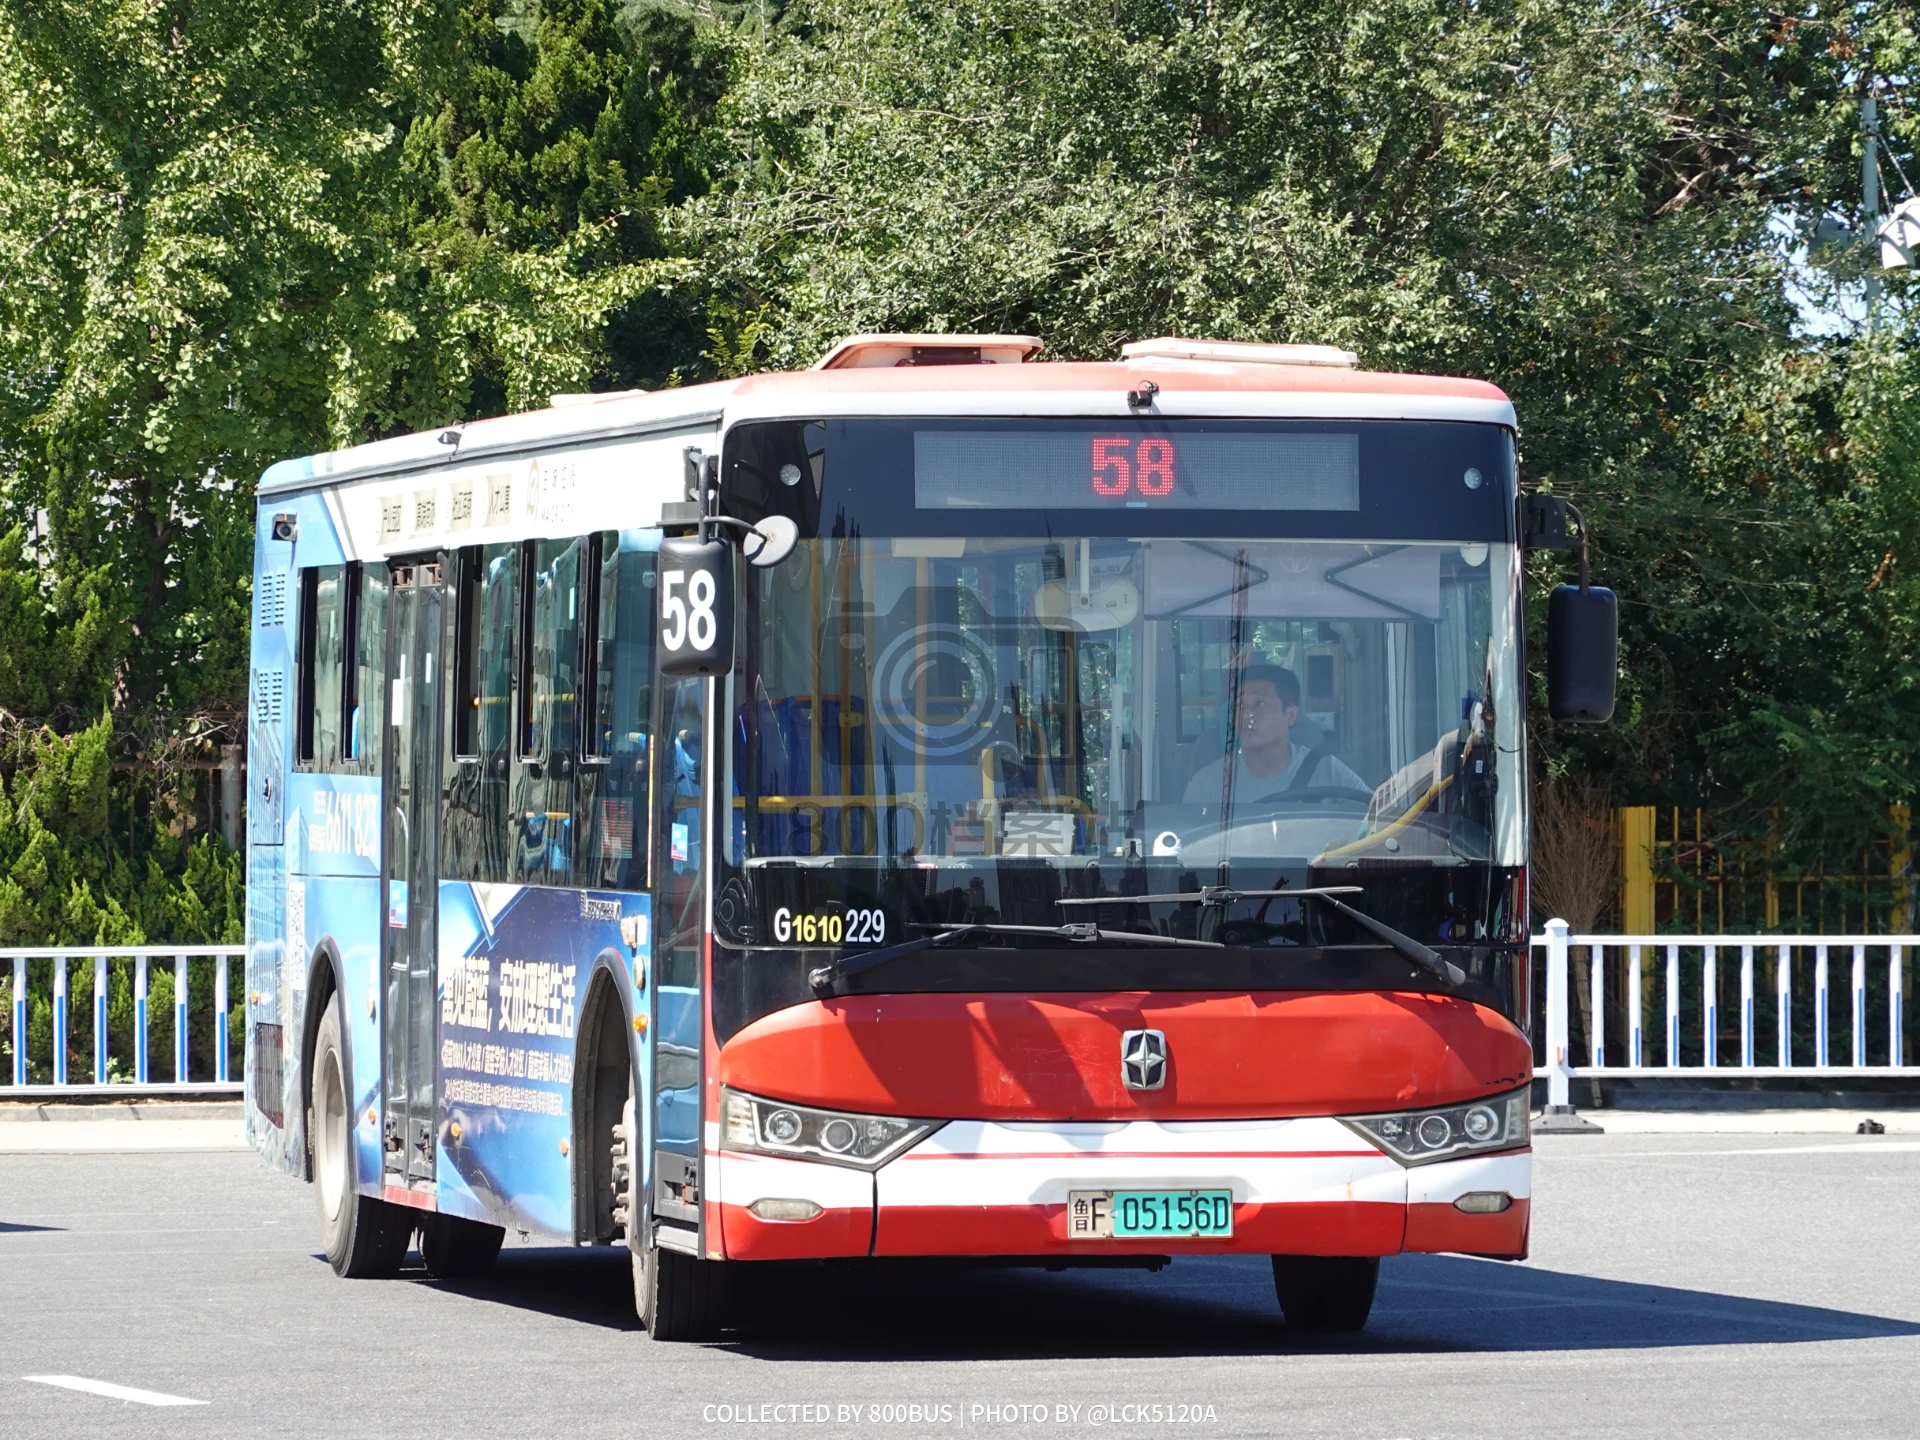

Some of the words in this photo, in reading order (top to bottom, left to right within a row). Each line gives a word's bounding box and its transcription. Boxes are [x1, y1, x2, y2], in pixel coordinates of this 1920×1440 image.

[1093, 438, 1174, 496] 58
[662, 569, 717, 652] 58
[326, 790, 352, 854] 6611
[354, 791, 378, 857] 823
[774, 907, 885, 943] G1610229
[1073, 1197, 1107, 1232] 鲁F
[1123, 1196, 1229, 1231] 05156D
